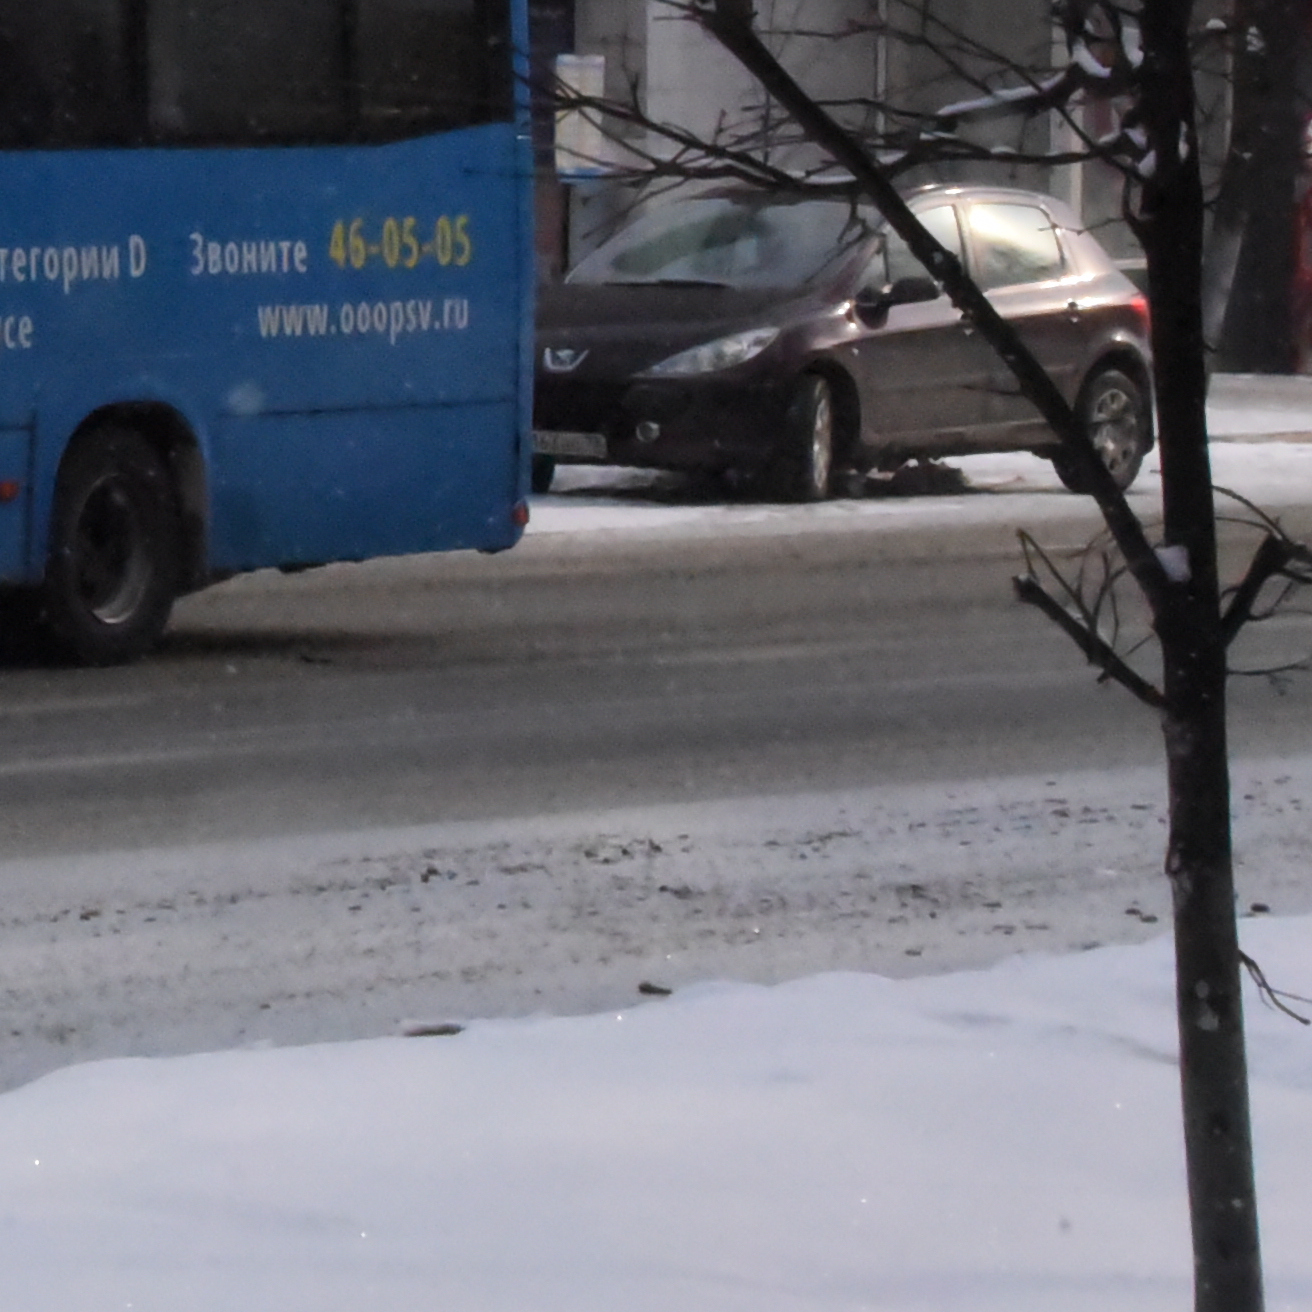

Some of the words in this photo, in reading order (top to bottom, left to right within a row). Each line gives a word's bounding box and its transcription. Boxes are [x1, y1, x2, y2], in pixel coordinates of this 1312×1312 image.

[128, 234, 147, 278] D
[189, 231, 308, 276] Звоните
[329, 214, 473, 269] 46-05-05
[257, 298, 469, 345] www.ooopsv.ru
